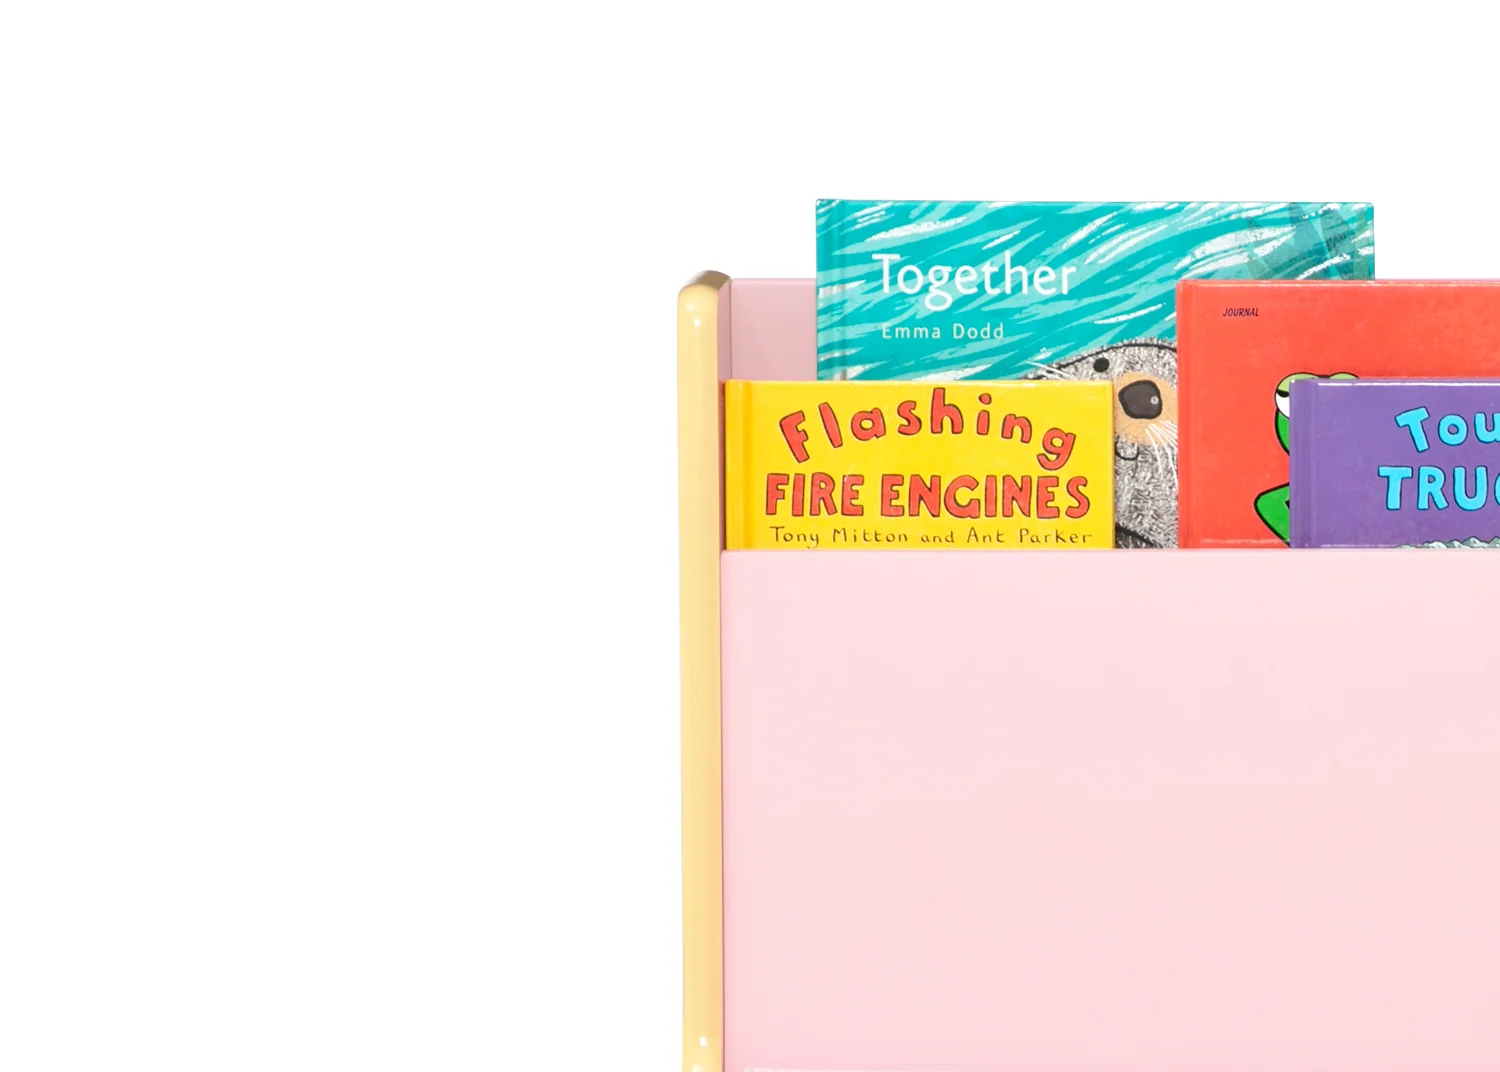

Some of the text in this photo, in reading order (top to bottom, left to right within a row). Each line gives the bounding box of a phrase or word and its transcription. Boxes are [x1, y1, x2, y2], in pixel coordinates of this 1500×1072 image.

[872, 253, 1077, 311] Together
[1222, 307, 1260, 318] JOURNAL
[881, 322, 1004, 340] Emma Dodd
[779, 387, 1077, 471] Flashing
[765, 472, 1091, 519] FIRE ENGINES
[769, 526, 1093, 549] Tony Mitton and Ant Parker
